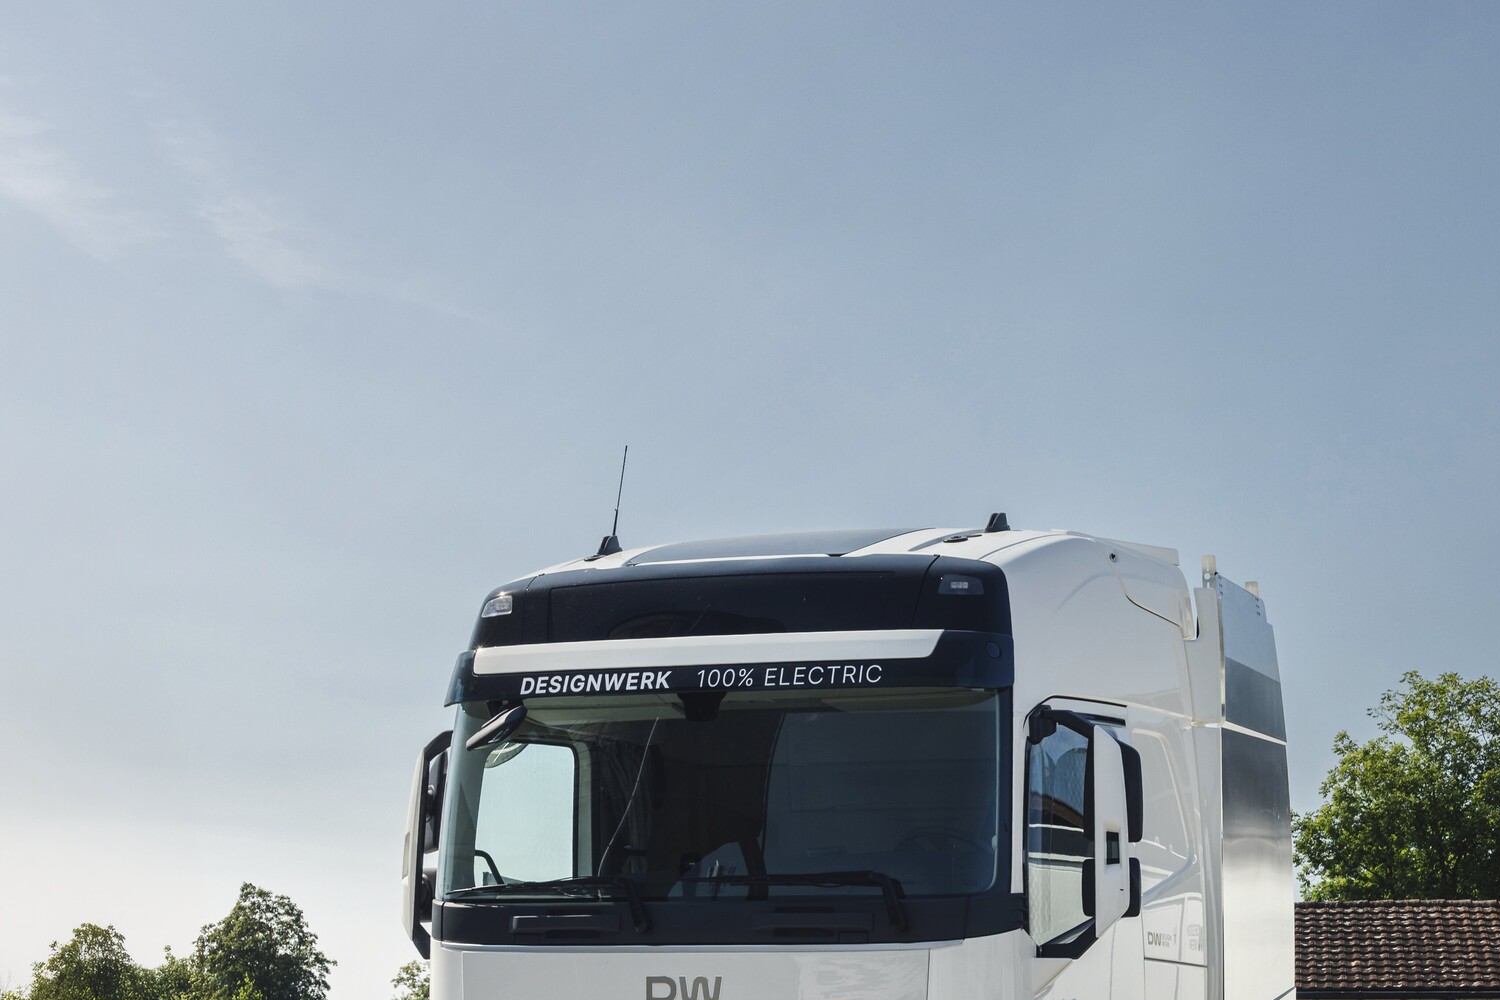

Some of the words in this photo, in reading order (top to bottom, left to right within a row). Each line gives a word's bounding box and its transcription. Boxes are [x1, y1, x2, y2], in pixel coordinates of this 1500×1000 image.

[520, 670, 673, 695] DESIGNWERK
[697, 667, 755, 688] 100%
[763, 664, 883, 687] ELECTRIC
